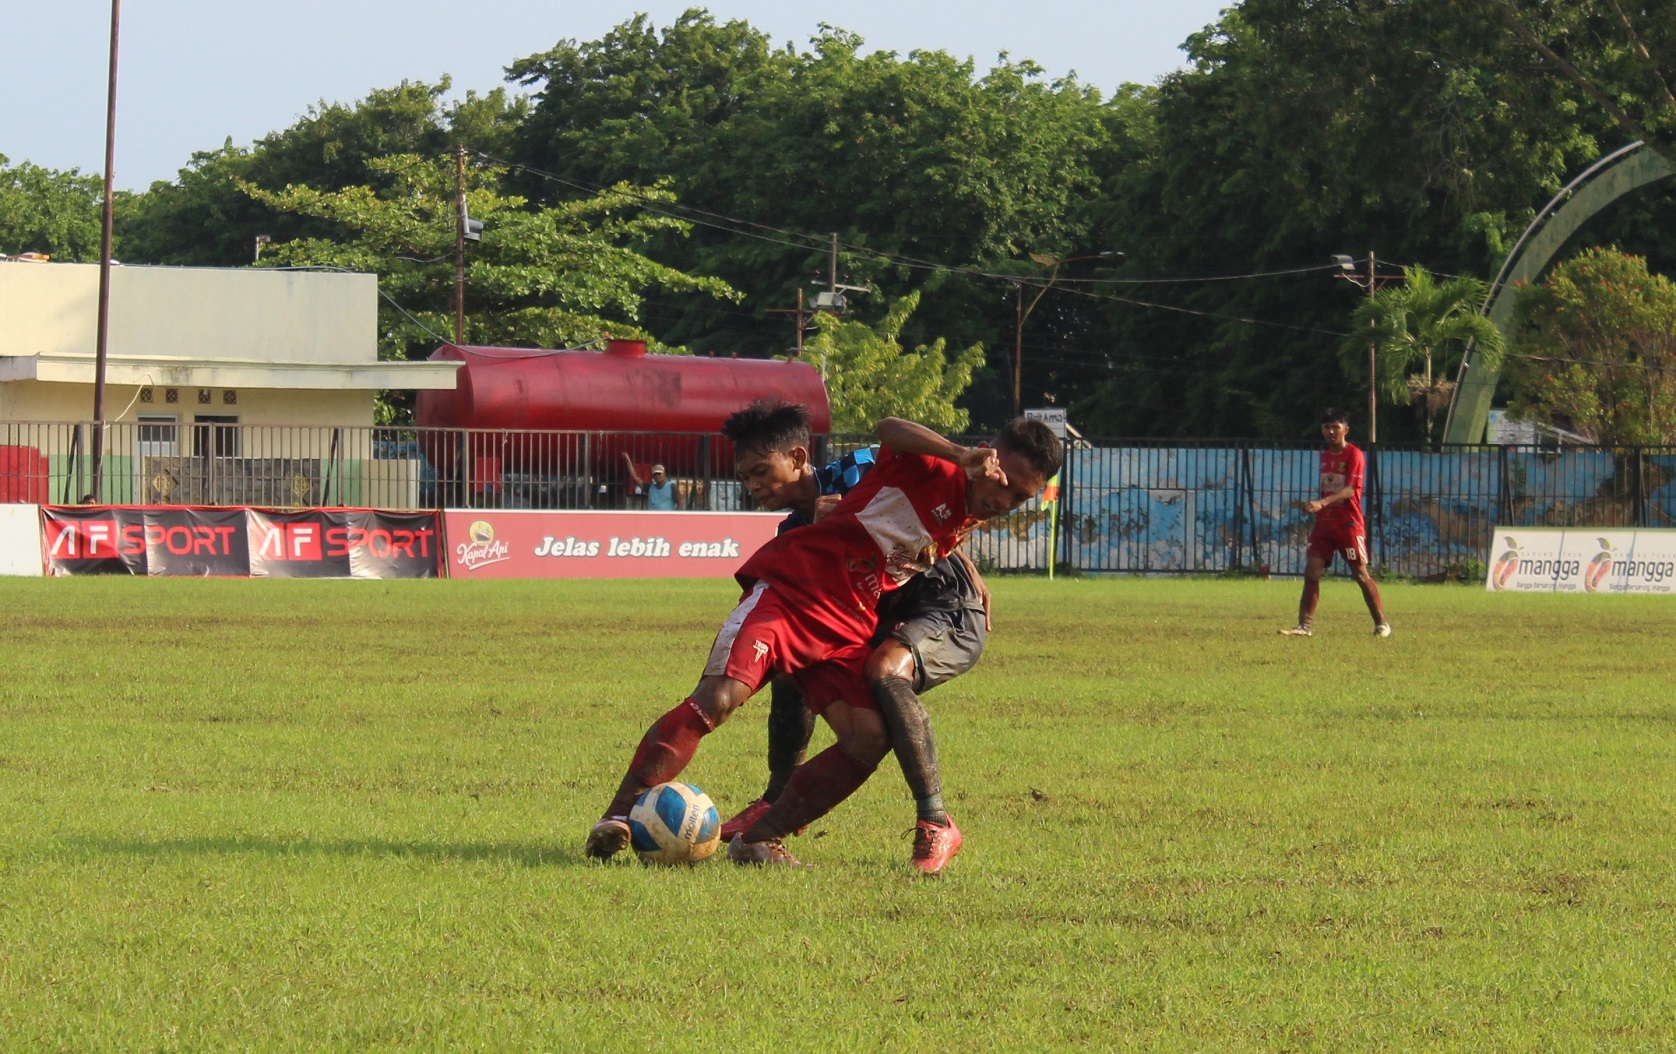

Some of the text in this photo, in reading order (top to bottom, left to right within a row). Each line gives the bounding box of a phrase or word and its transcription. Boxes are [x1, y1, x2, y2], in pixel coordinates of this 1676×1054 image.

[121, 525, 236, 556] SPORT
[325, 527, 434, 559] SPORT
[534, 536, 740, 558] Jelas lebih enak
[1346, 547, 1357, 561] 18
[1518, 559, 1580, 581] mangga
[1611, 560, 1674, 583] mangga
[684, 804, 700, 840] molten
